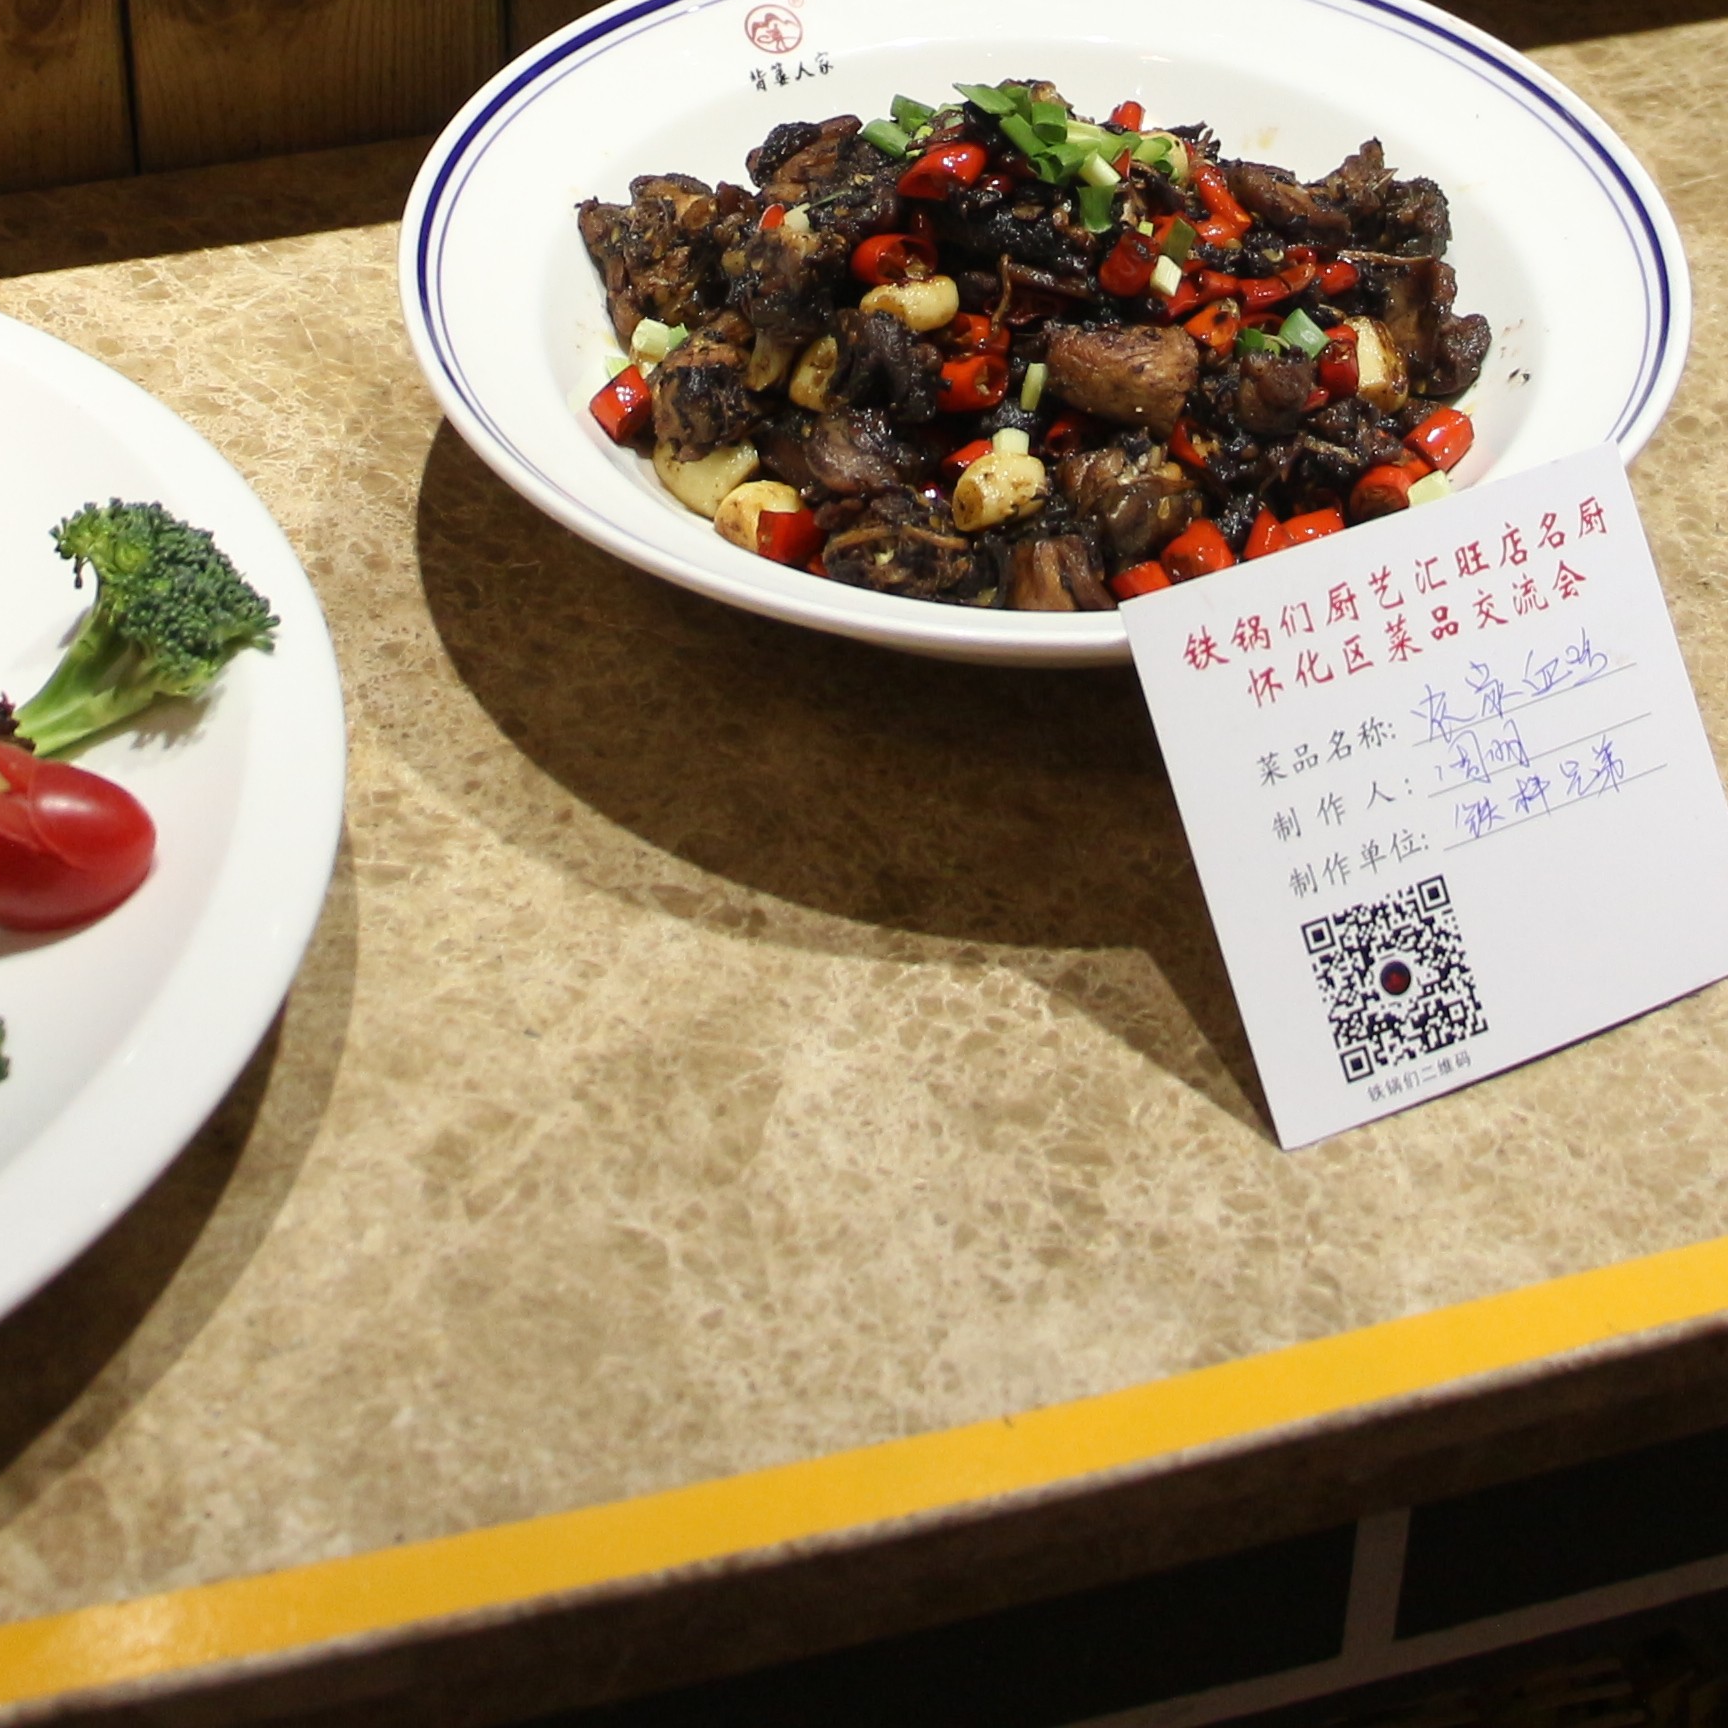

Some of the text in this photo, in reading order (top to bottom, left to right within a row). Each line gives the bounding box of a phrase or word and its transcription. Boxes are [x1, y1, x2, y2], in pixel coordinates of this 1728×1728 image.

[1183, 495, 1606, 670] 铁锅们厨艺汇旺店名厨
[1247, 559, 1586, 707] 怀化区菜品交流会
[1368, 1050, 1472, 1102] 铁锅们二维码
